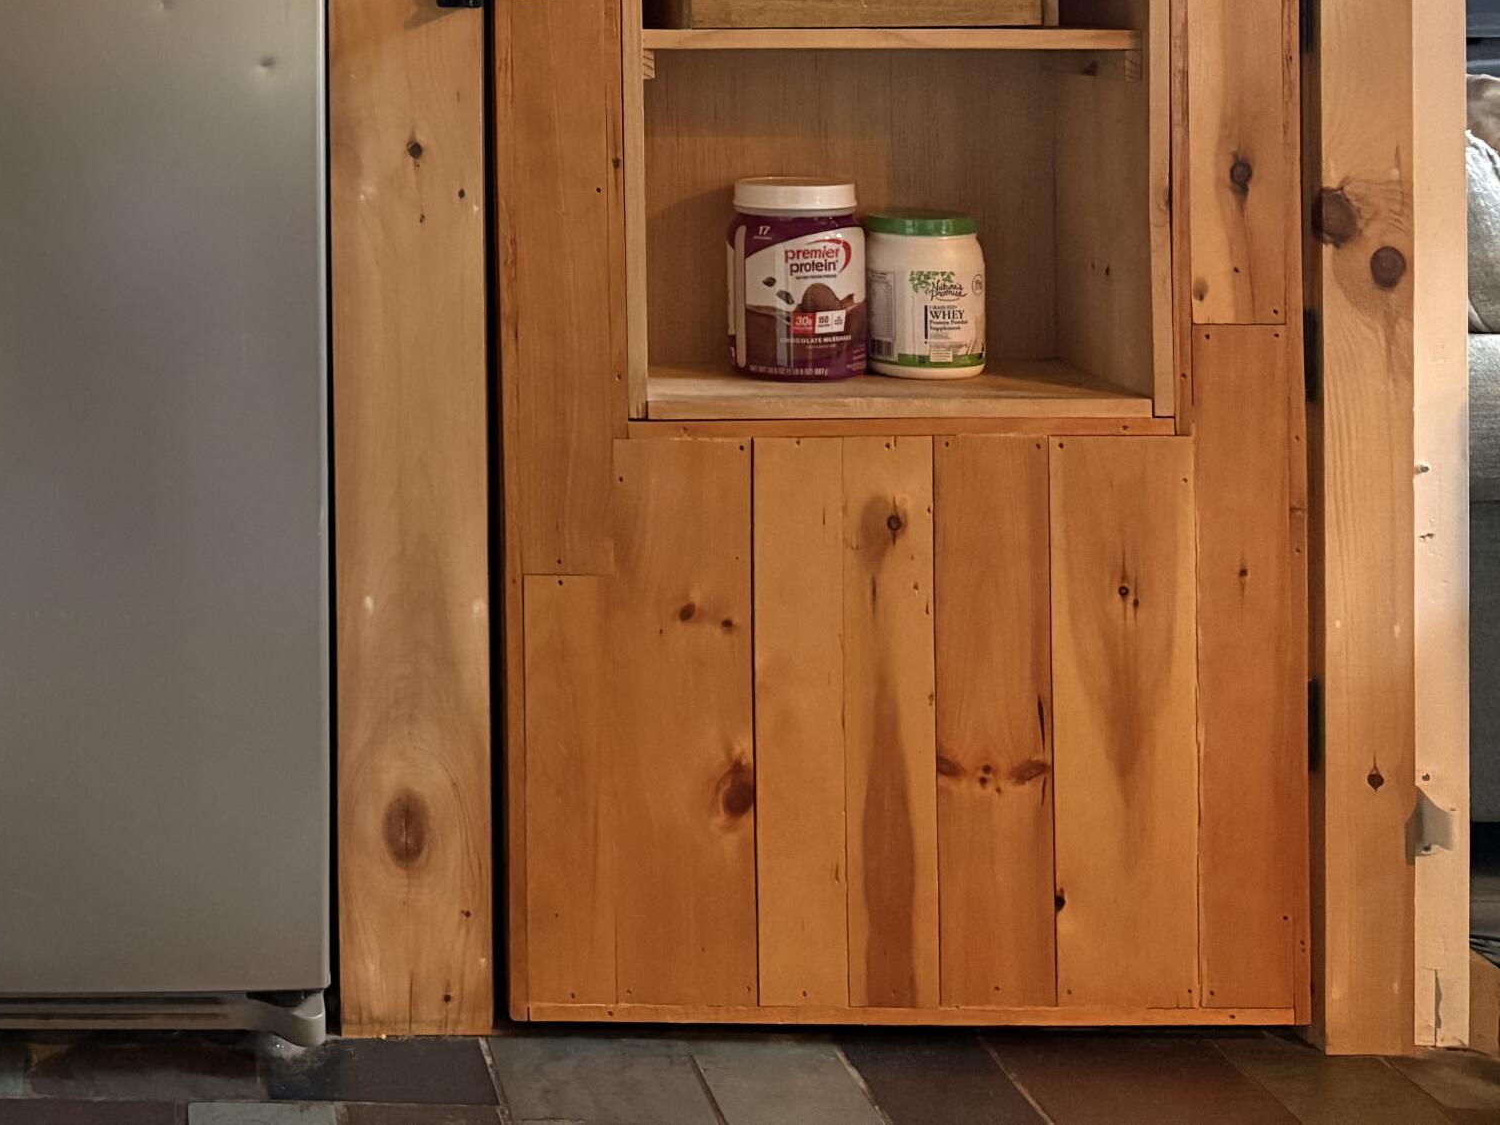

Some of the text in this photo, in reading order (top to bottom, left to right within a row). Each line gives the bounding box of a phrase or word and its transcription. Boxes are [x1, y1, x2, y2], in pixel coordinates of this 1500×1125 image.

[758, 225, 771, 235] 17
[784, 245, 840, 263] premier
[789, 259, 838, 276] protein
[929, 310, 965, 320] WHEY
